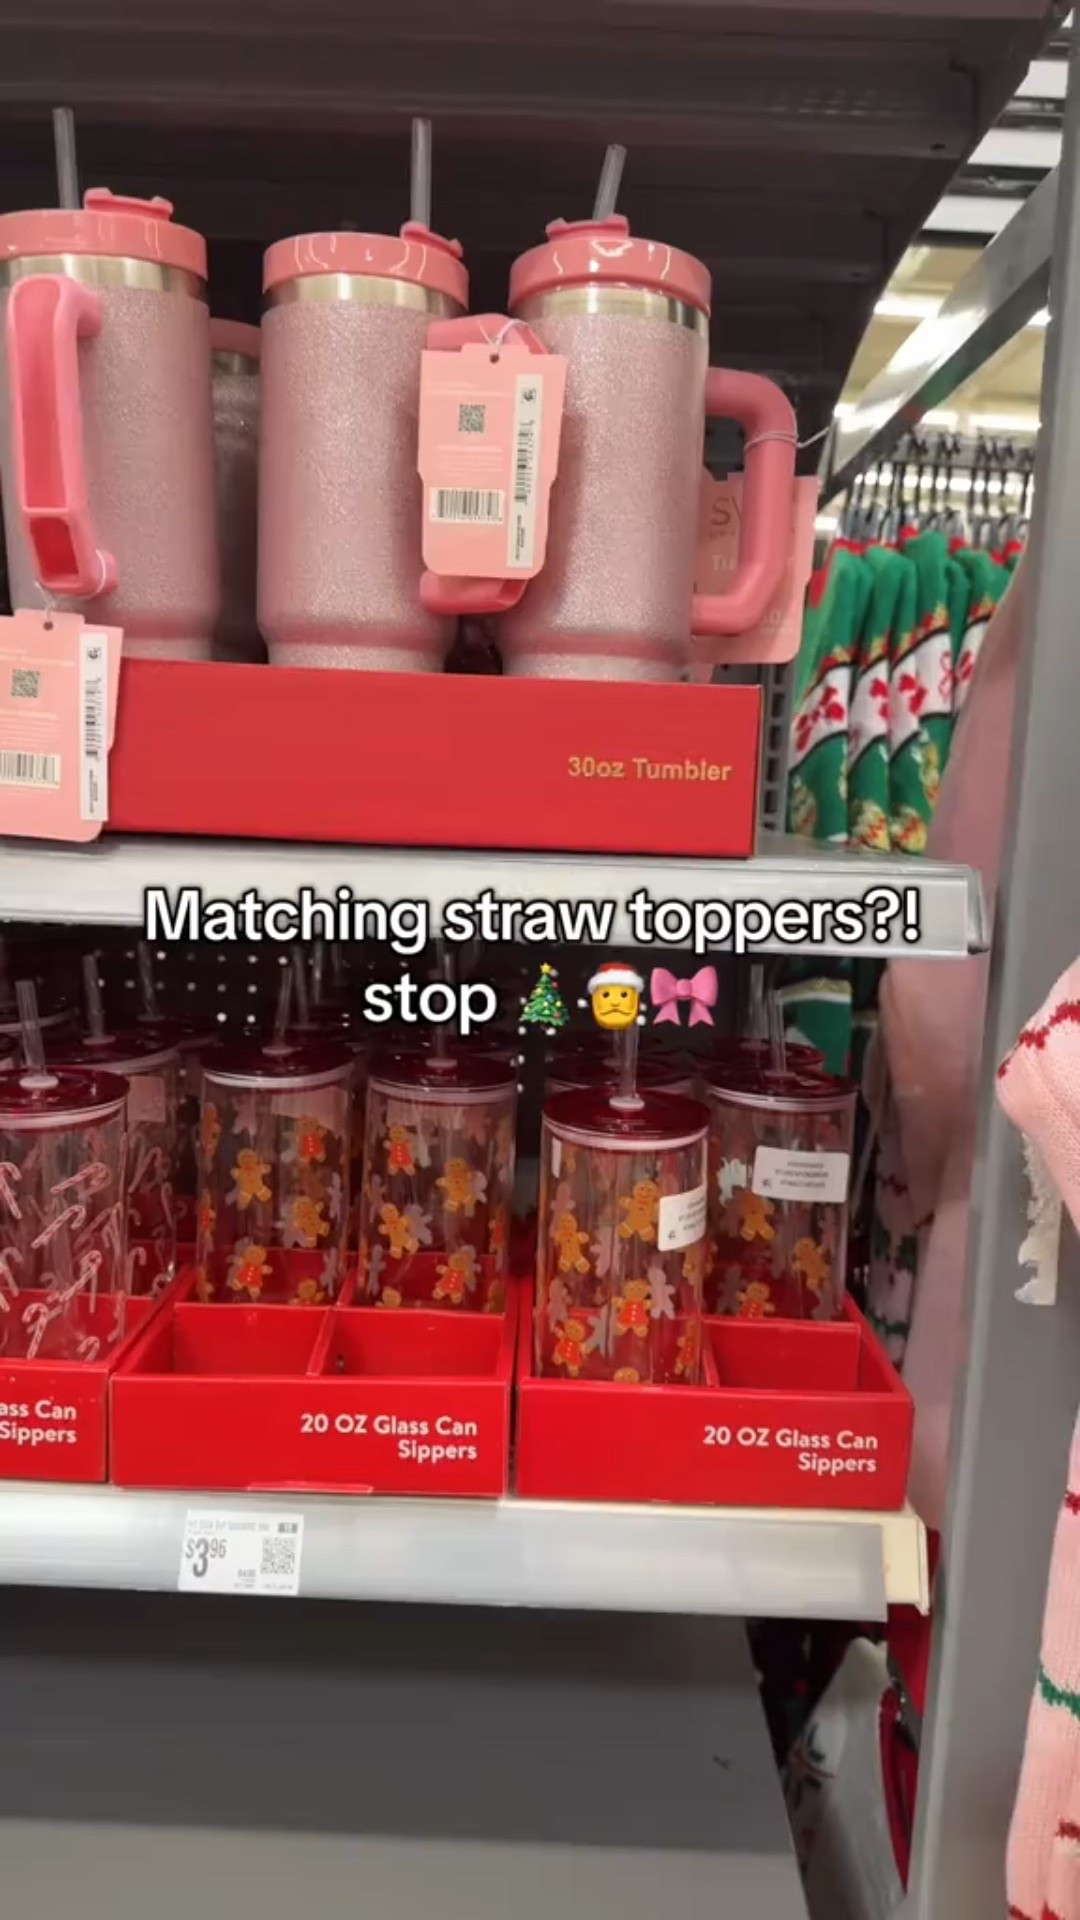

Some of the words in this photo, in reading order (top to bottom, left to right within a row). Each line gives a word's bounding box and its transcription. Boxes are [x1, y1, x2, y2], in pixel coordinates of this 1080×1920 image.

[567, 756, 625, 778] 30oz
[632, 757, 732, 781] Tumbler
[35, 1399, 77, 1420] Can
[0, 1420, 77, 1446] Sippers
[300, 1413, 329, 1433] 20
[335, 1414, 368, 1434] OZ
[373, 1415, 430, 1435] Glass
[435, 1416, 477, 1436] Can
[703, 1425, 731, 1445] 20
[737, 1427, 770, 1447] OZ
[775, 1428, 831, 1448] Glass
[836, 1430, 878, 1450] Can
[398, 1439, 477, 1463] Sippers
[798, 1452, 877, 1476] Sippers
